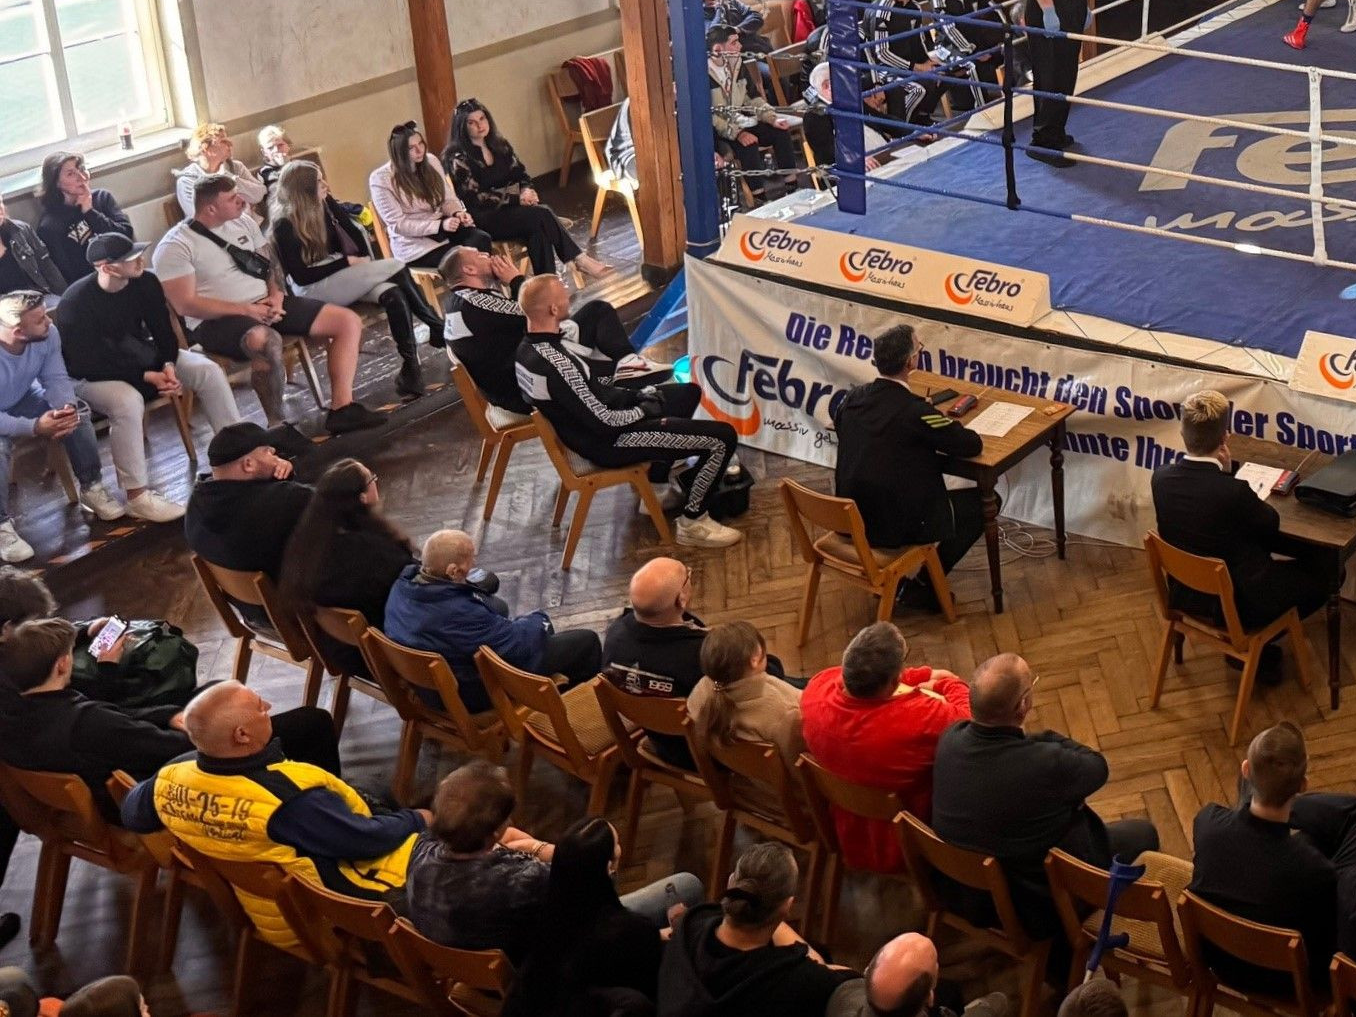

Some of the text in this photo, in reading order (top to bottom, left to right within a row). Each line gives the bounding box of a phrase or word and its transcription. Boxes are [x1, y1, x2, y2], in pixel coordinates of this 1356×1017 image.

[760, 228, 811, 254] Febro
[860, 248, 913, 274] Febro
[966, 269, 1021, 297] Febro
[785, 312, 832, 351] Die
[835, 324, 932, 373] Ren
[939, 349, 1050, 399] braucht
[1052, 373, 1107, 415] den
[1114, 386, 1182, 421] Spor
[1228, 401, 1268, 439] er
